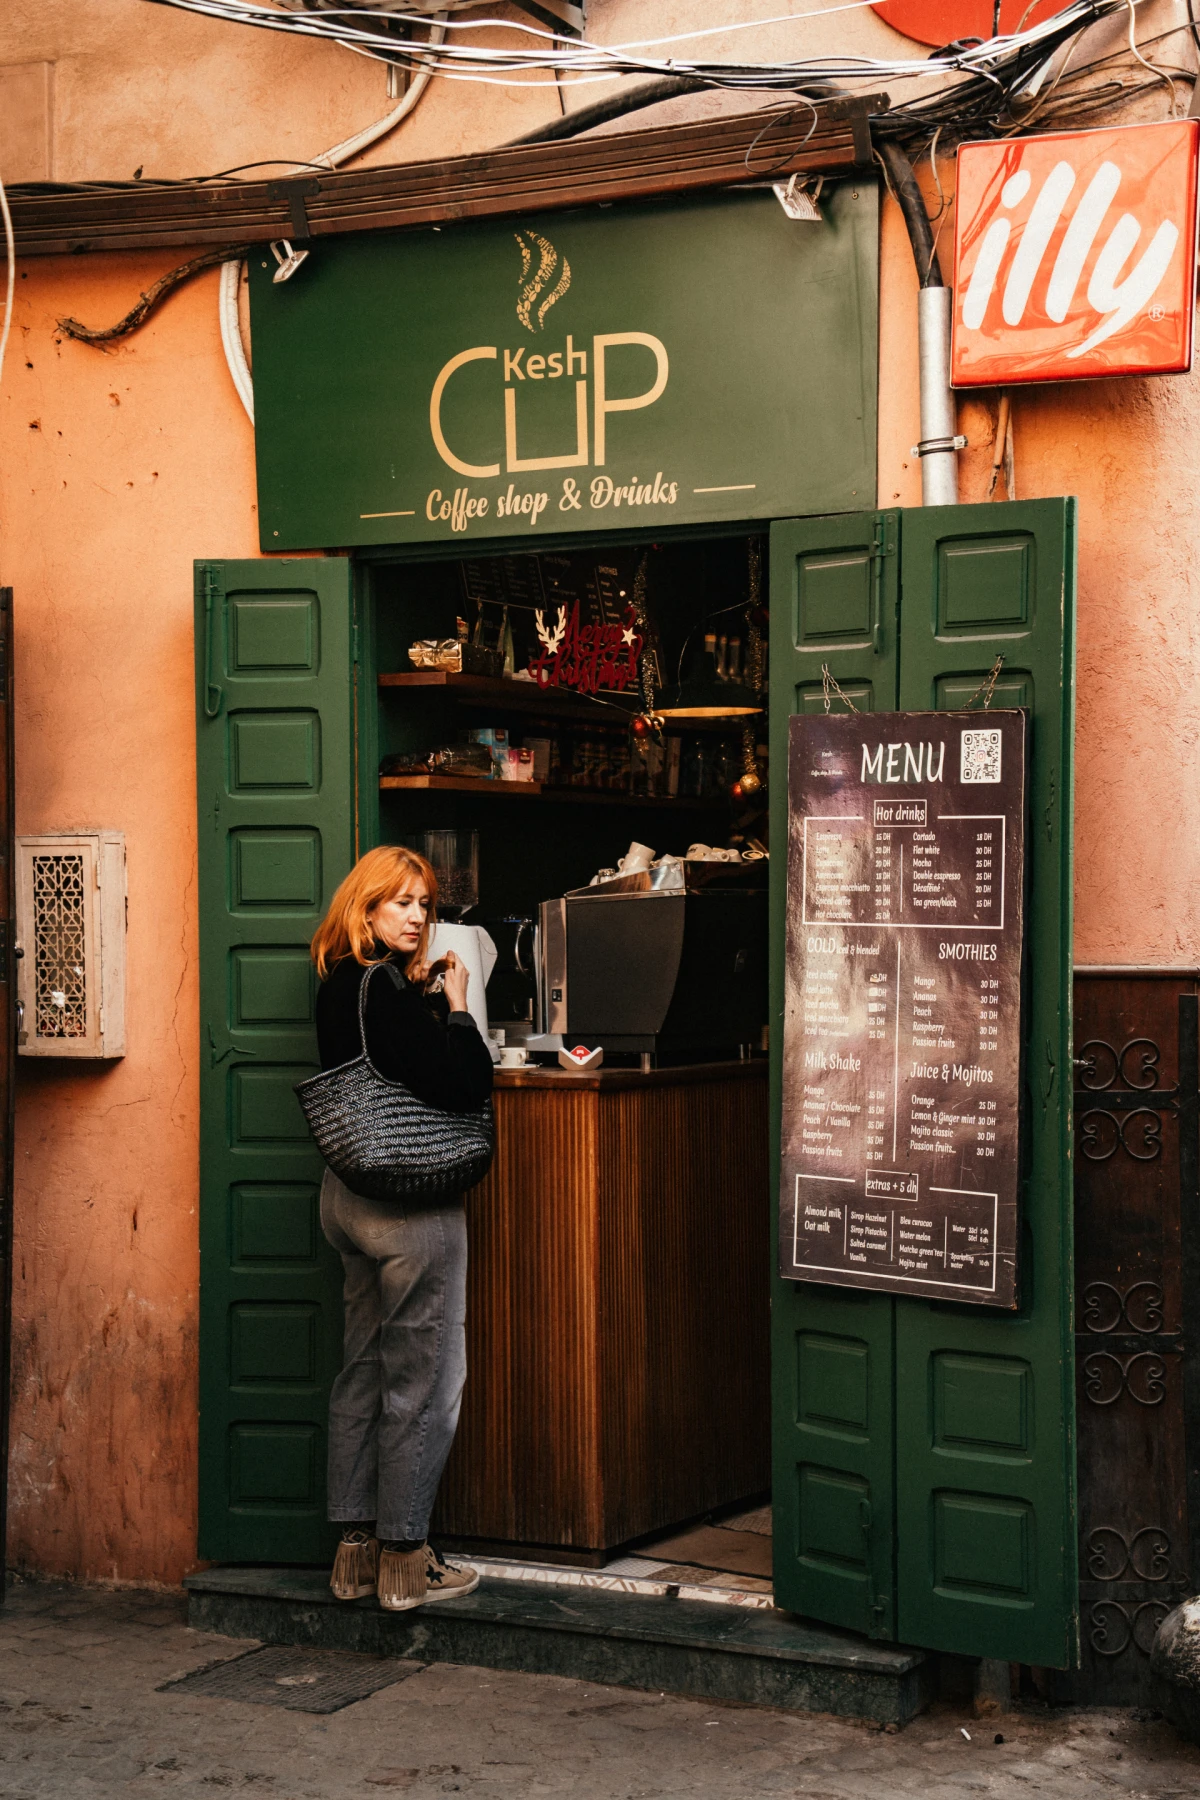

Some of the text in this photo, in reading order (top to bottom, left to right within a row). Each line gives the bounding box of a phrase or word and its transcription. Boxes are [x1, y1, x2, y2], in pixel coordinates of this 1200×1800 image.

[962, 160, 1179, 358] illy
[504, 335, 587, 382] Kesh
[430, 332, 669, 478] CUP
[426, 472, 679, 532] Coffee shop & Drinks
[860, 741, 946, 784] MENU
[876, 804, 925, 822] Hot drinks
[913, 831, 936, 840] Cortado
[913, 845, 924, 854] Flat
[925, 845, 940, 854] white
[913, 858, 932, 867] Mocha
[913, 870, 933, 880] Double
[913, 898, 922, 906] Tea
[807, 937, 836, 953] COLD
[856, 944, 880, 955] blended
[939, 942, 997, 960] SMOTHIES
[878, 973, 887, 982] DH
[914, 976, 936, 989] Mango
[990, 980, 998, 988] DH
[913, 991, 937, 1001] Ananas
[989, 996, 998, 1004] DH
[877, 1004, 886, 1012] DH
[913, 1006, 932, 1016] Peach
[989, 1011, 998, 1020] DH
[877, 1030, 886, 1039] DH
[912, 1021, 945, 1035] Raspberry
[989, 1027, 997, 1035] DH
[912, 1036, 997, 1050] Passion fruits 30 DH
[804, 1051, 861, 1072] Milk Shake
[910, 1062, 994, 1087] Juice & Mojitos
[804, 1085, 824, 1098] Mango
[876, 1090, 885, 1099] DH
[803, 1100, 825, 1110] Ananas
[831, 1101, 861, 1113] Chocolate
[876, 1106, 884, 1114] DH
[911, 1094, 996, 1110] Orange 25 DH
[803, 1114, 820, 1124] Peach
[830, 1116, 850, 1127] Vanilla
[875, 1120, 884, 1129] DH
[911, 1110, 996, 1126] Lemon & Ginger mint 30 DH
[802, 1129, 833, 1143] Raspberry
[875, 1136, 883, 1145] DH
[910, 1125, 930, 1138] Mojito
[932, 1126, 953, 1138] classic
[986, 1132, 995, 1141] DH
[802, 1144, 824, 1155] Passion
[826, 1146, 842, 1157] fruits
[874, 1152, 883, 1160] DH
[910, 1140, 934, 1150] Passion
[985, 1148, 994, 1156] DH
[867, 1179, 890, 1191] extras
[900, 1182, 905, 1193] 5
[907, 1180, 917, 1193] dh
[805, 1205, 842, 1220] Almond milk
[851, 1211, 887, 1223] Sirop Hazelnut
[804, 1221, 830, 1233] Oat milk
[900, 1216, 911, 1225] Bleu
[850, 1225, 888, 1237] Sirop Pistachio
[900, 1230, 931, 1241] Water melon
[850, 1239, 886, 1251] Salted caramel
[899, 1244, 918, 1254] Matcha
[919, 1247, 933, 1257] green
[850, 1253, 867, 1262] Vanilla
[899, 1258, 928, 1270] Mojito mint
